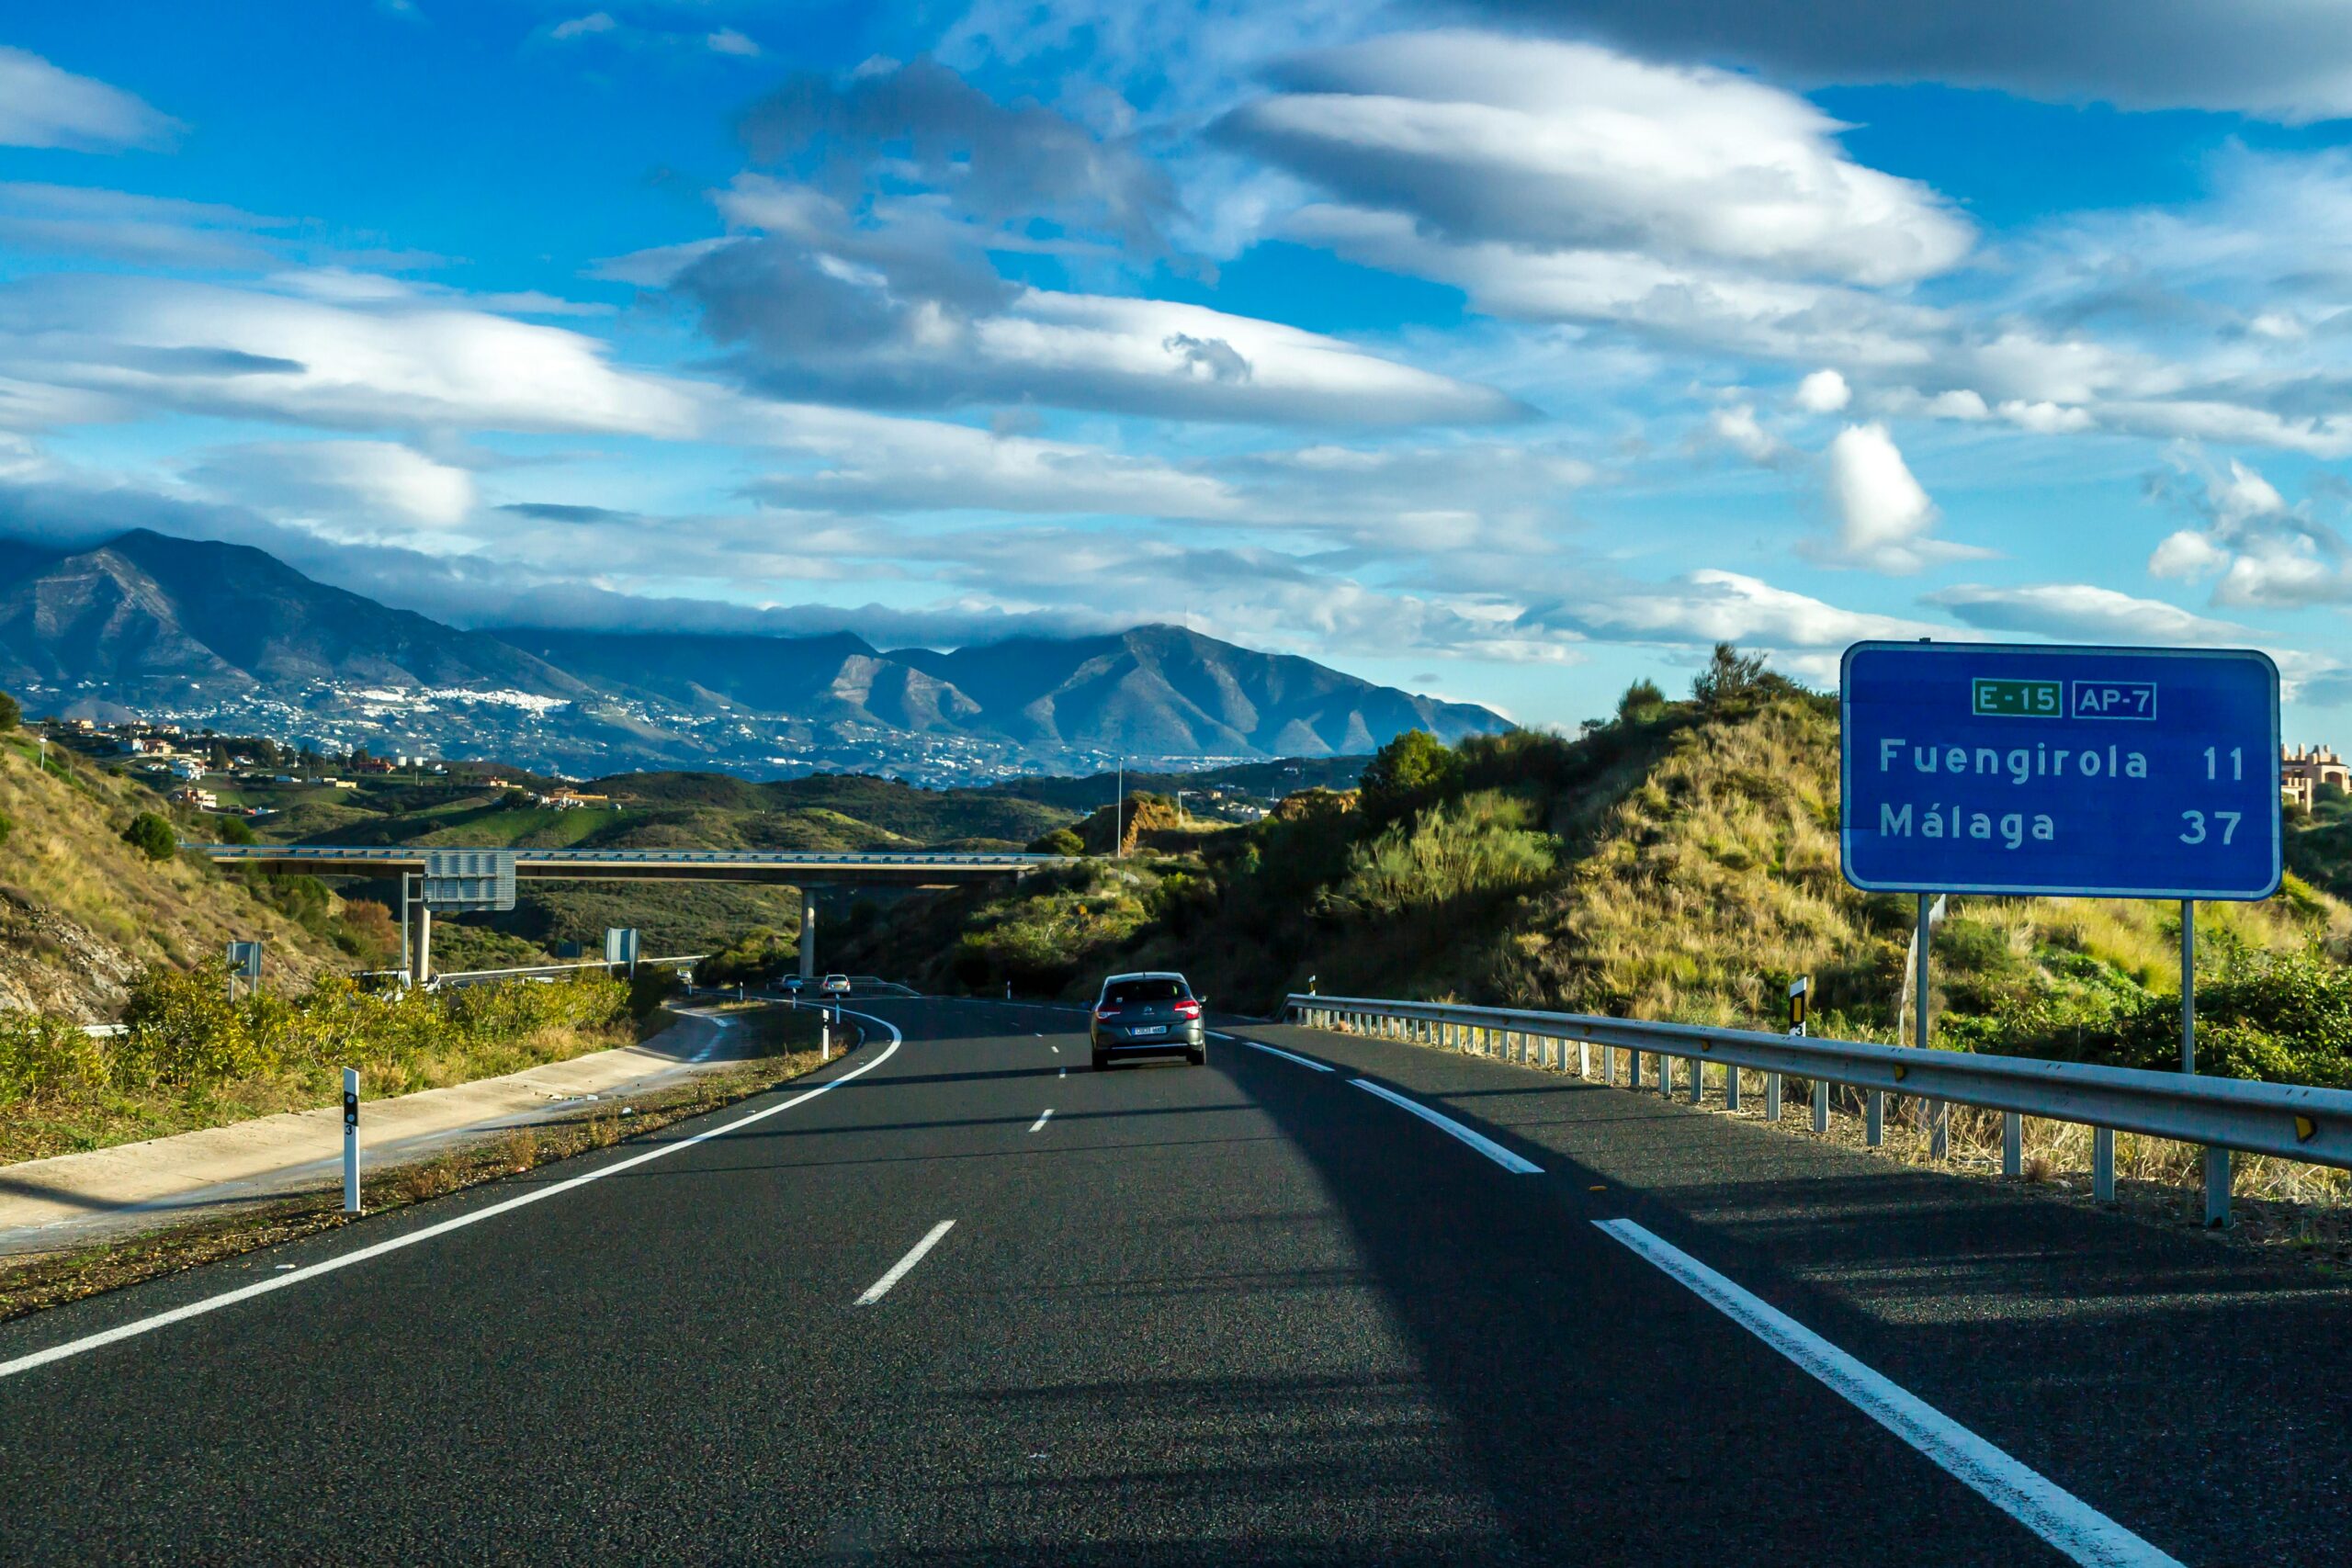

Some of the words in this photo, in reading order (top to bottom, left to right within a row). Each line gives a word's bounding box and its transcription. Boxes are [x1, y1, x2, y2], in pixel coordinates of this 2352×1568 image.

[1980, 686, 2054, 711] E-15
[2079, 689, 2150, 712] AP-7
[1881, 739, 2146, 784] Fuengirola
[2203, 747, 2242, 780] 11
[1881, 803, 2054, 850] Málaga
[2178, 809, 2242, 845] 37
[345, 1124, 353, 1135] 3
